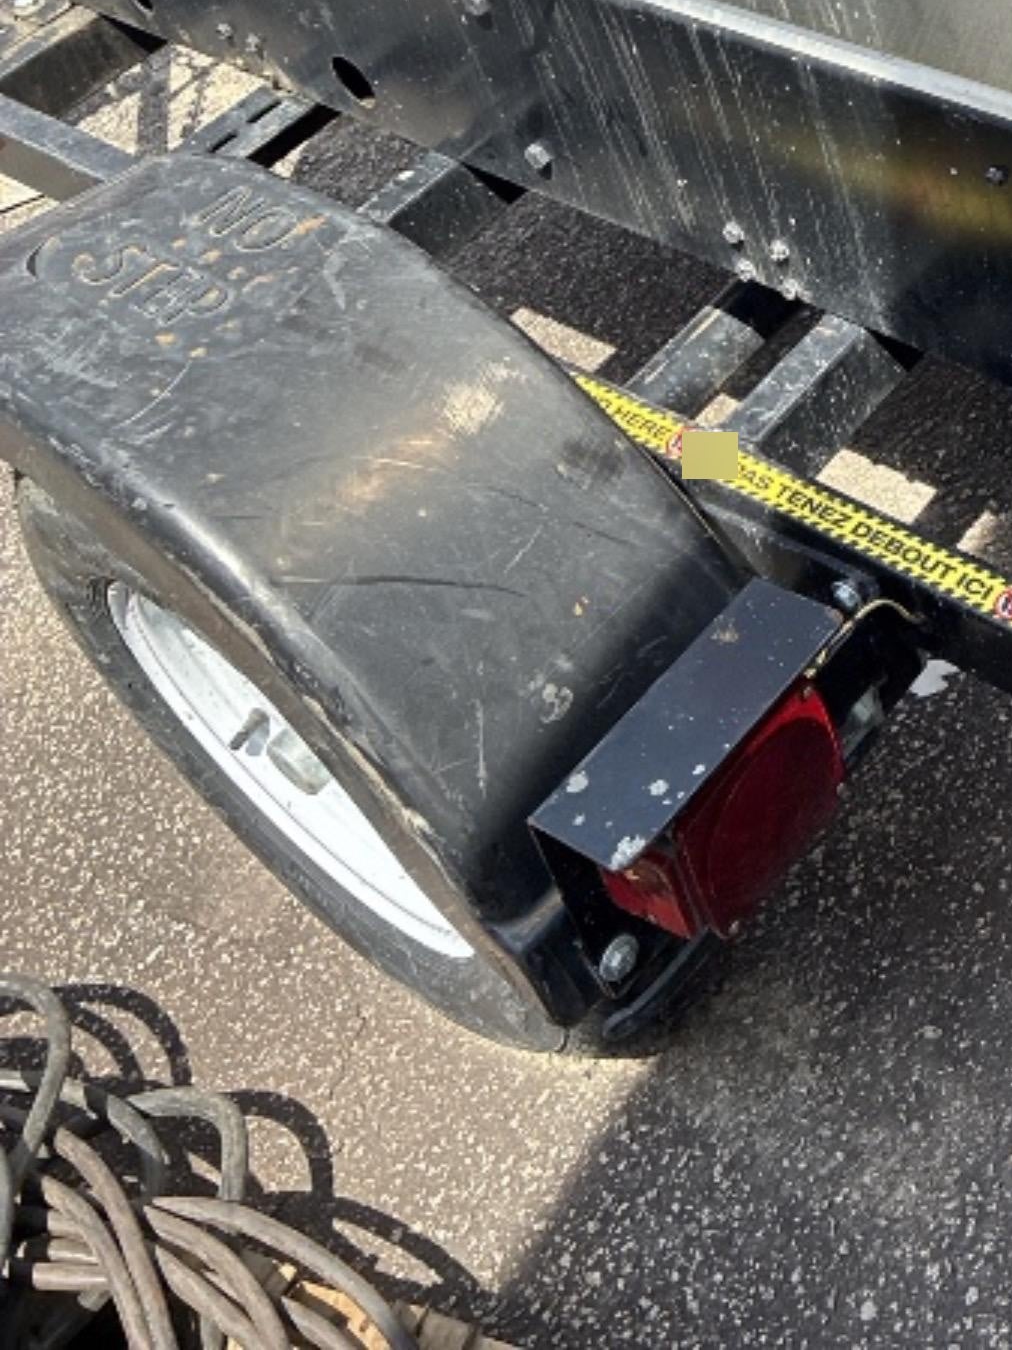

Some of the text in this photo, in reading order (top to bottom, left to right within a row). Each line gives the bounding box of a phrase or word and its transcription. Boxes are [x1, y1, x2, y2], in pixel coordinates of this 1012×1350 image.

[776, 482, 852, 529] TENEZ
[849, 520, 959, 579] DEBOUT
[954, 571, 994, 600] ICI
